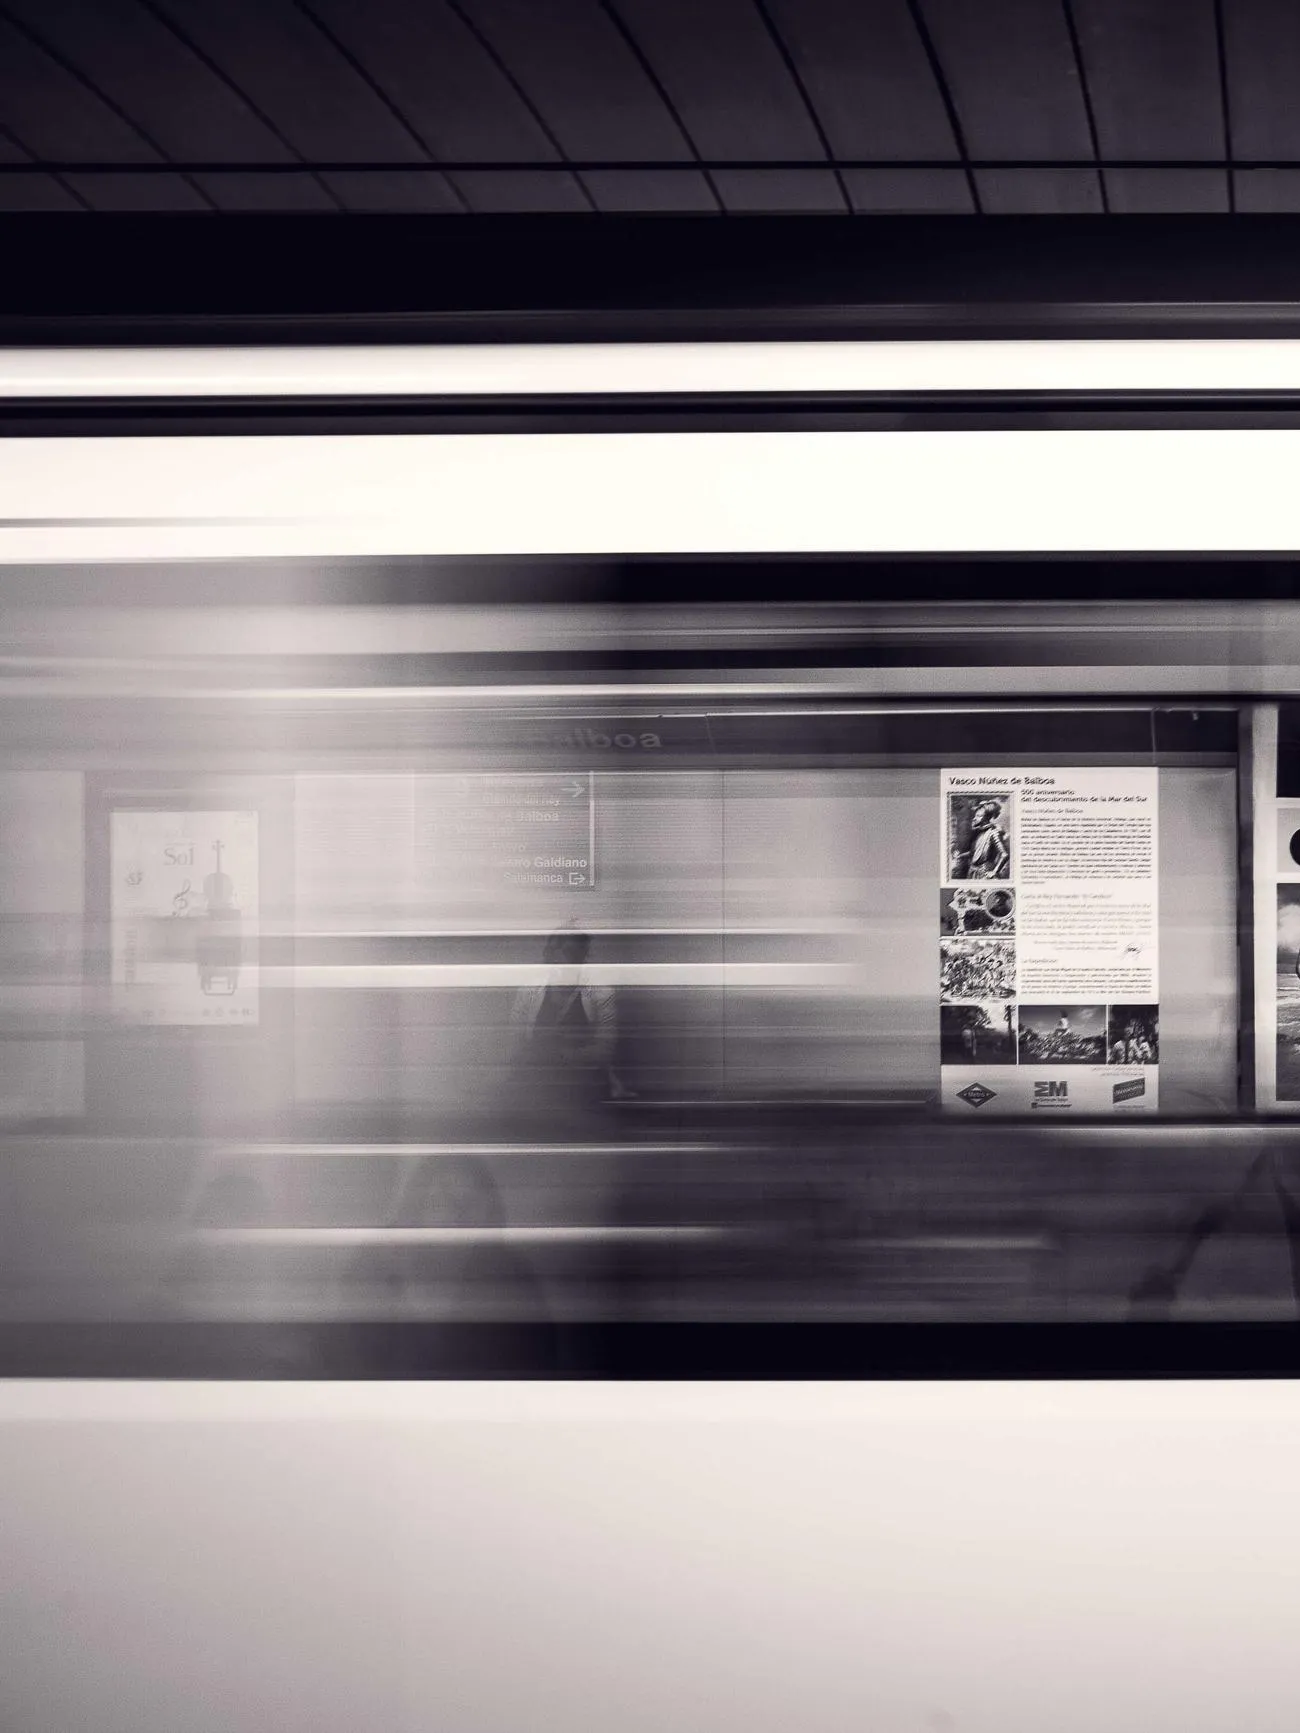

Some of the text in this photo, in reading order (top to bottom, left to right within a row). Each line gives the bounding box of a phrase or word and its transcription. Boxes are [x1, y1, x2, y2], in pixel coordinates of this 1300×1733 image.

[950, 776, 1055, 785] Vasco Núñez de Balboa
[534, 856, 588, 868] Galdiano
